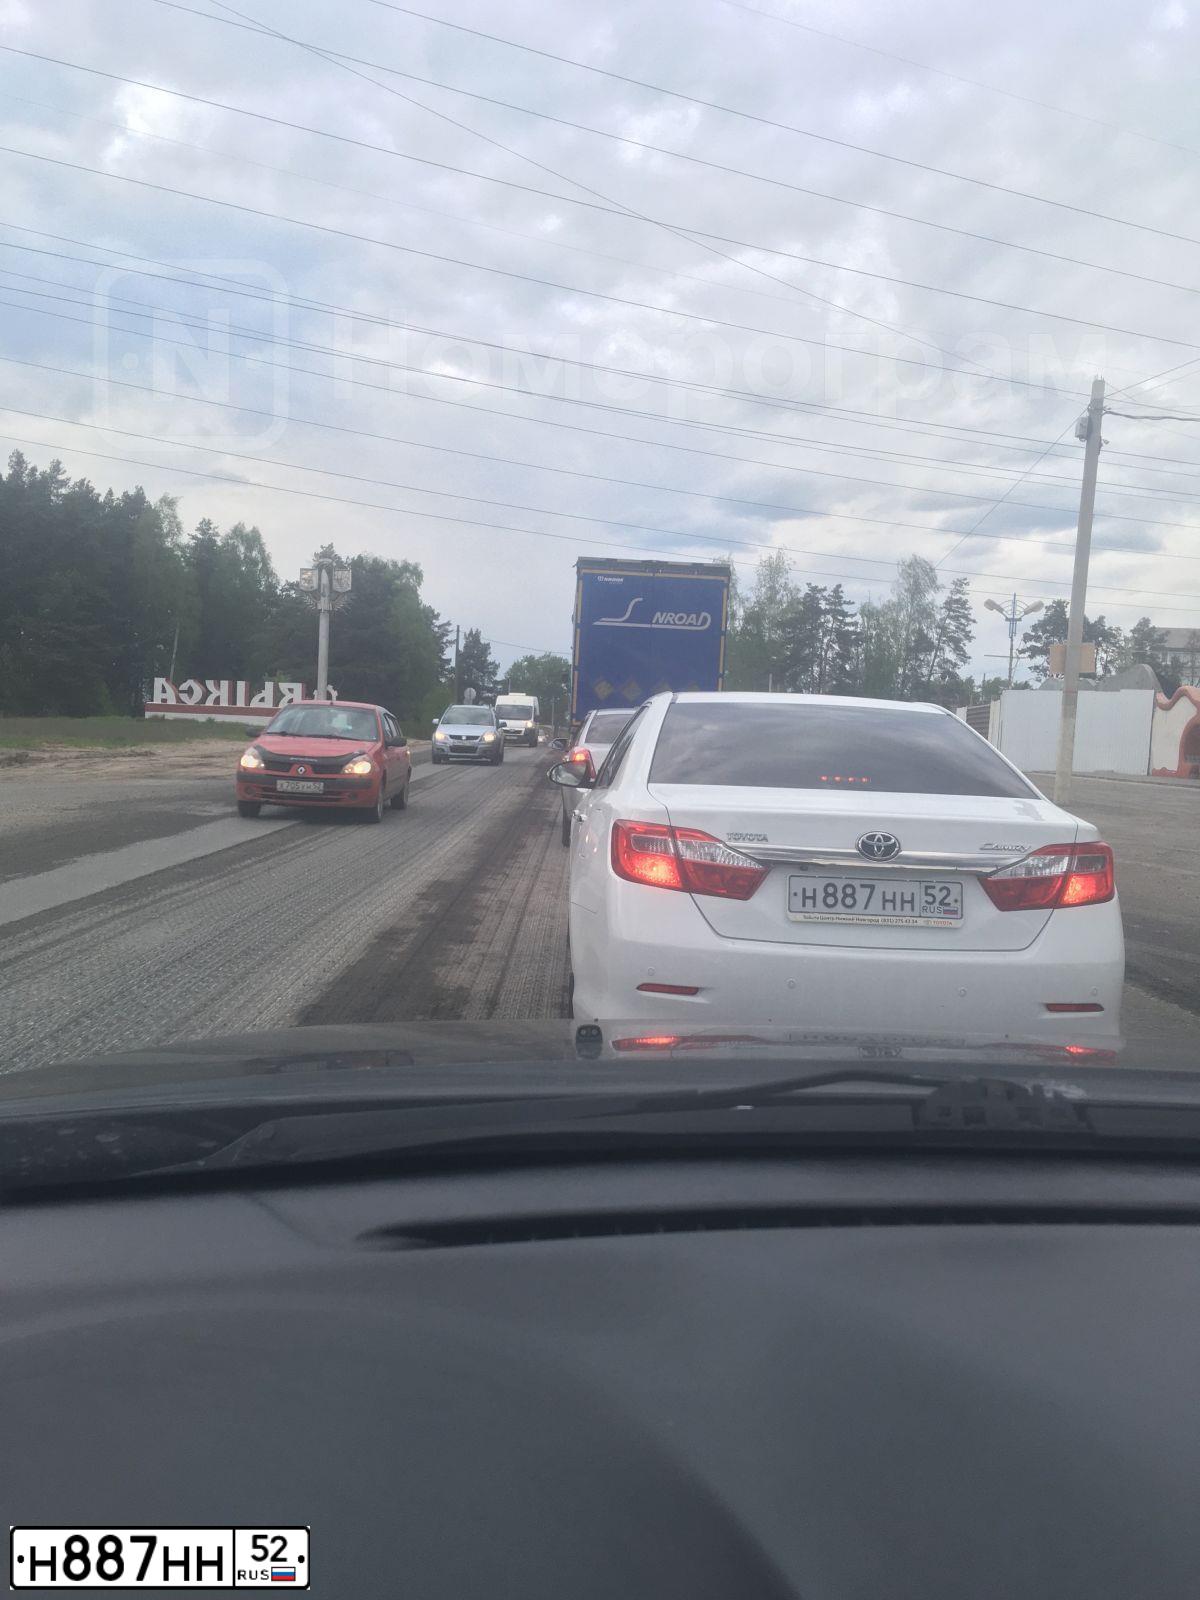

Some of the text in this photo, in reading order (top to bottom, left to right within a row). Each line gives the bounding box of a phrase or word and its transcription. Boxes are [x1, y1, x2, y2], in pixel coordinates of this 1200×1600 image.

[726, 832, 769, 842] TOYOTA
[924, 885, 951, 907] 52
[921, 905, 942, 915] RUS
